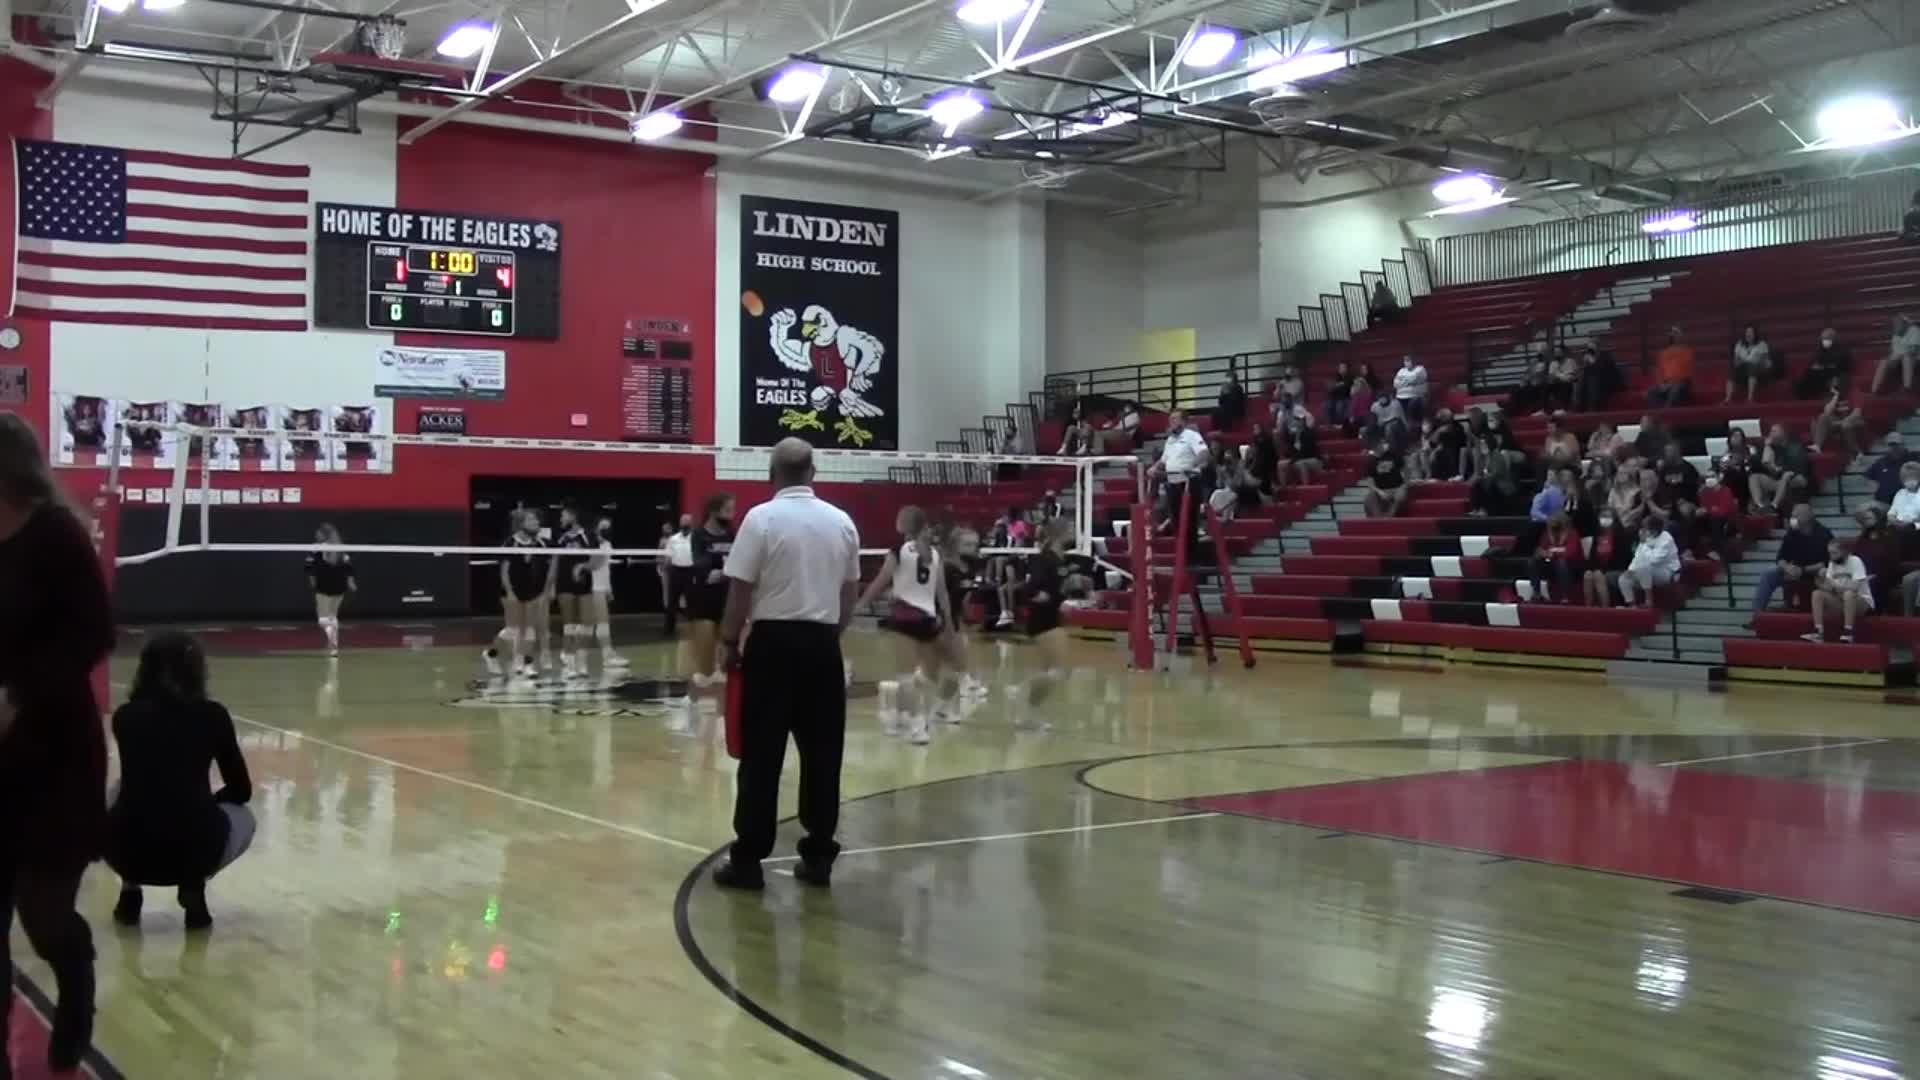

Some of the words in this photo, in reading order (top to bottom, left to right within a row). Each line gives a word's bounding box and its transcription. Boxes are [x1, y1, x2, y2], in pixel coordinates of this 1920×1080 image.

[322, 208, 381, 236] HOME
[388, 213, 415, 239] OF
[420, 215, 455, 242] THE
[462, 220, 531, 248] EAGLES
[753, 210, 887, 247] LINDEN
[375, 246, 402, 257] HOME
[431, 251, 473, 273] 1:00
[396, 259, 404, 281] 1
[756, 252, 805, 270] HIGH
[811, 256, 881, 275] SCHOOL
[455, 280, 461, 296] 1
[496, 267, 511, 289] 4
[390, 304, 402, 321] 0
[491, 309, 503, 327] 0
[756, 388, 807, 406] EAGLES
